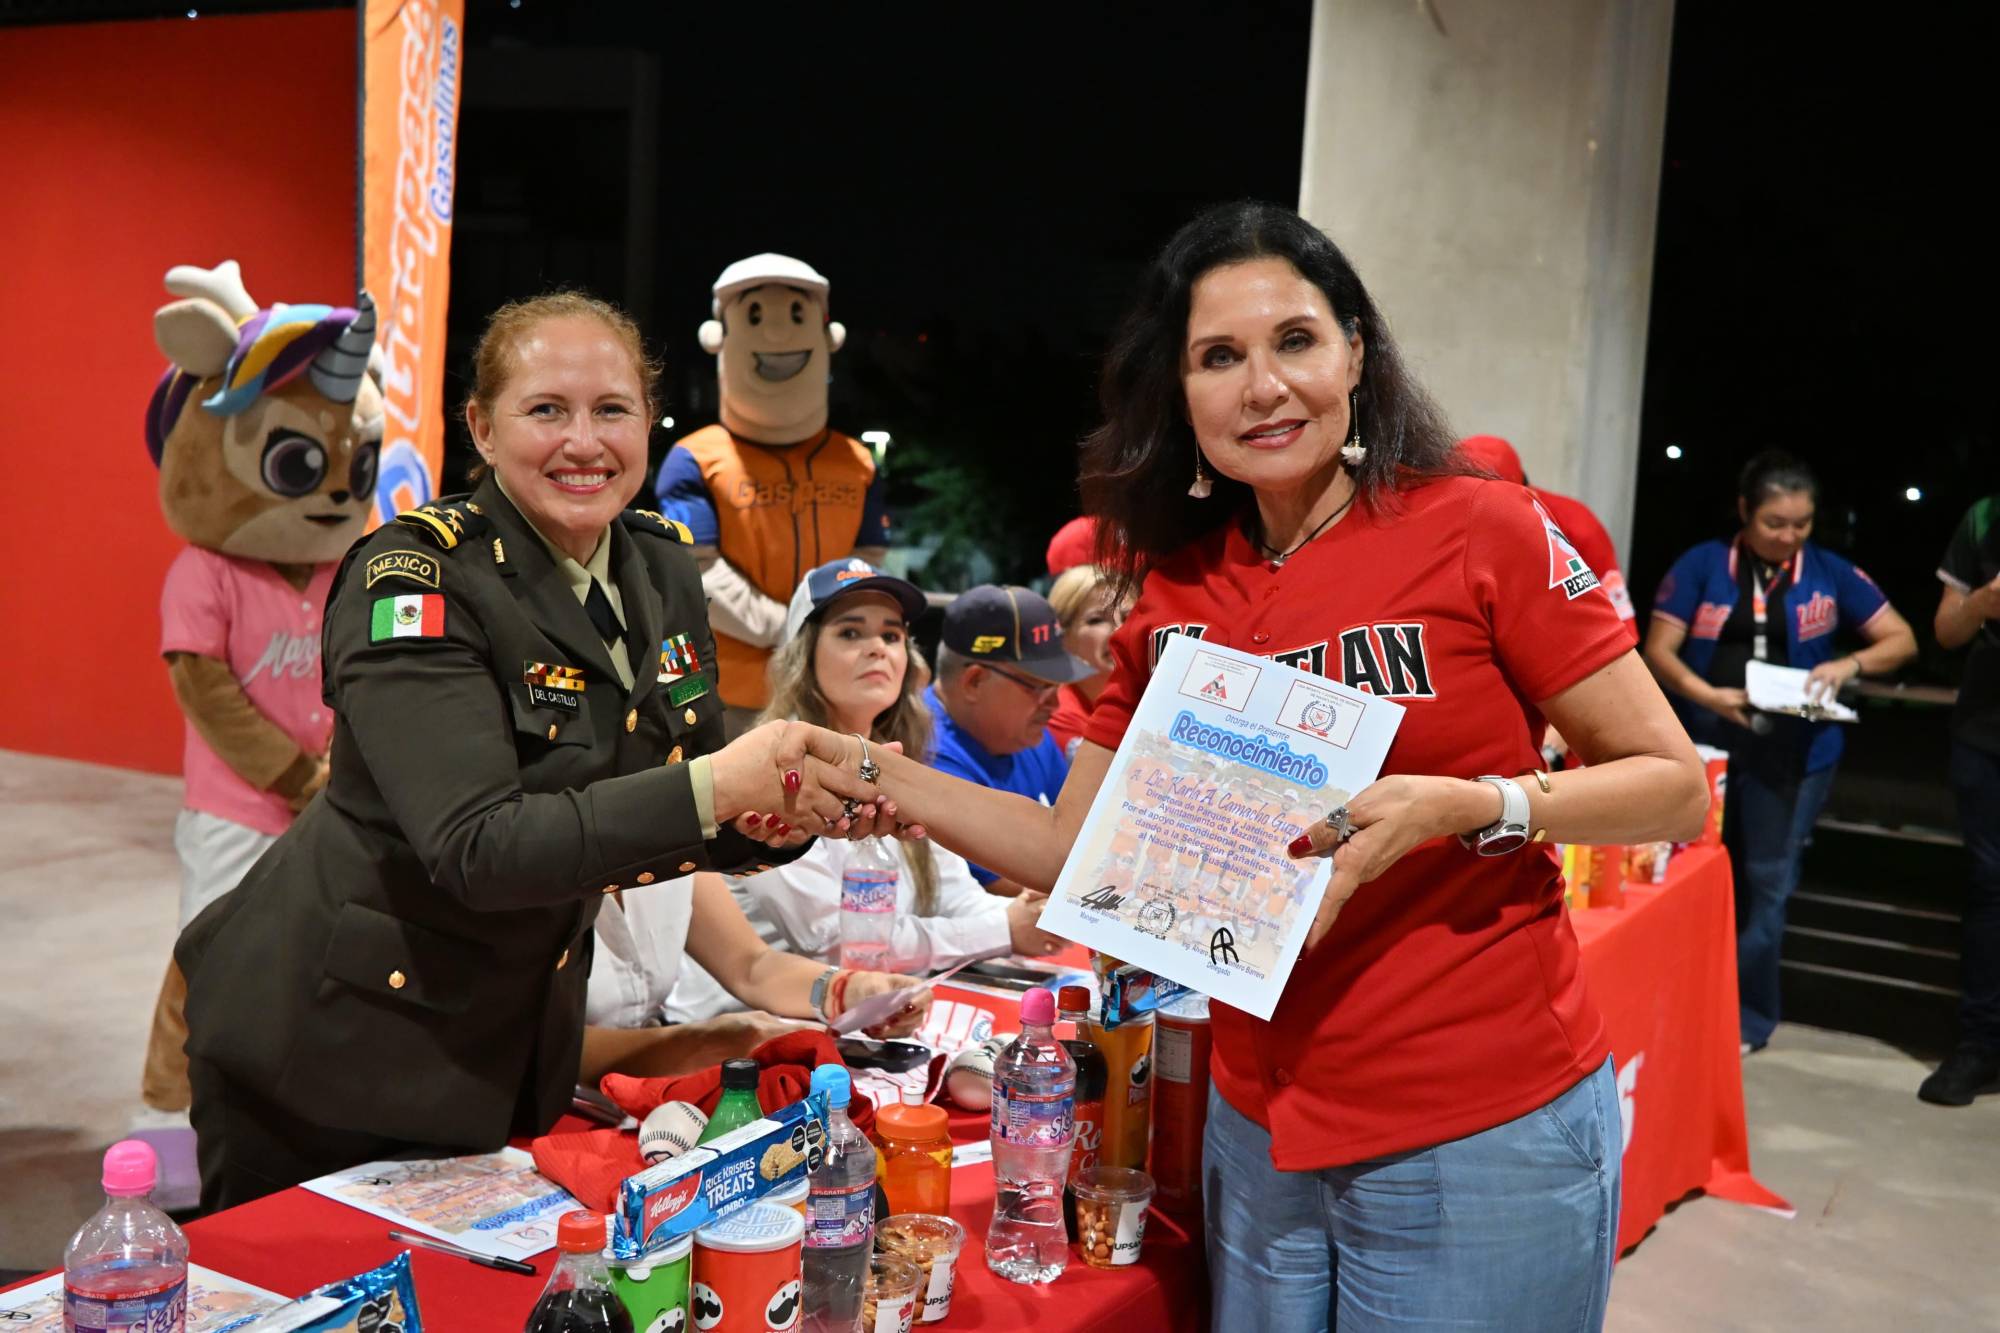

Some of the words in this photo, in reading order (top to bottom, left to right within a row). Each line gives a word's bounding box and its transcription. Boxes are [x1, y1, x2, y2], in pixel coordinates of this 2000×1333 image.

[430, 15, 457, 223] Gasolinas
[372, 556, 432, 576] MEXICO
[535, 689, 547, 701] DEL
[548, 692, 577, 707] CASTILLO
[1224, 713, 1250, 728] Otorga
[1248, 721, 1257, 730] el
[1257, 724, 1290, 741] Presente
[1174, 715, 1324, 785] Reconocimiento
[1145, 787, 1184, 808] Directora
[1183, 801, 1196, 811] de
[1195, 805, 1232, 825] Parques
[1239, 821, 1280, 842] Jardines
[1157, 802, 1216, 830] Ayuntamiento
[1216, 822, 1228, 832] de
[1219, 792, 1270, 826] Camacho
[1121, 800, 1137, 812] Por
[1137, 806, 1147, 815] el
[1146, 810, 1176, 827] apoyo
[1175, 820, 1237, 848] incondicional
[1237, 843, 1257, 856] que
[1257, 849, 1268, 859] le
[1134, 817, 1163, 833] dando
[1170, 830, 1180, 839] la
[1225, 849, 1272, 874] Pañalitos
[1137, 830, 1147, 840] al
[1147, 833, 1187, 854] Nacional
[1186, 849, 1199, 858] en
[1200, 852, 1258, 881] Guadalajara
[1205, 961, 1231, 978] Delegado
[1244, 966, 1266, 980] Barrera
[705, 1173, 722, 1191] RICE
[723, 1157, 756, 1178] KRISPIES
[707, 1171, 756, 1209] TREATS
[651, 1189, 688, 1218] Kellogg's
[716, 1200, 745, 1219] JUMBO
